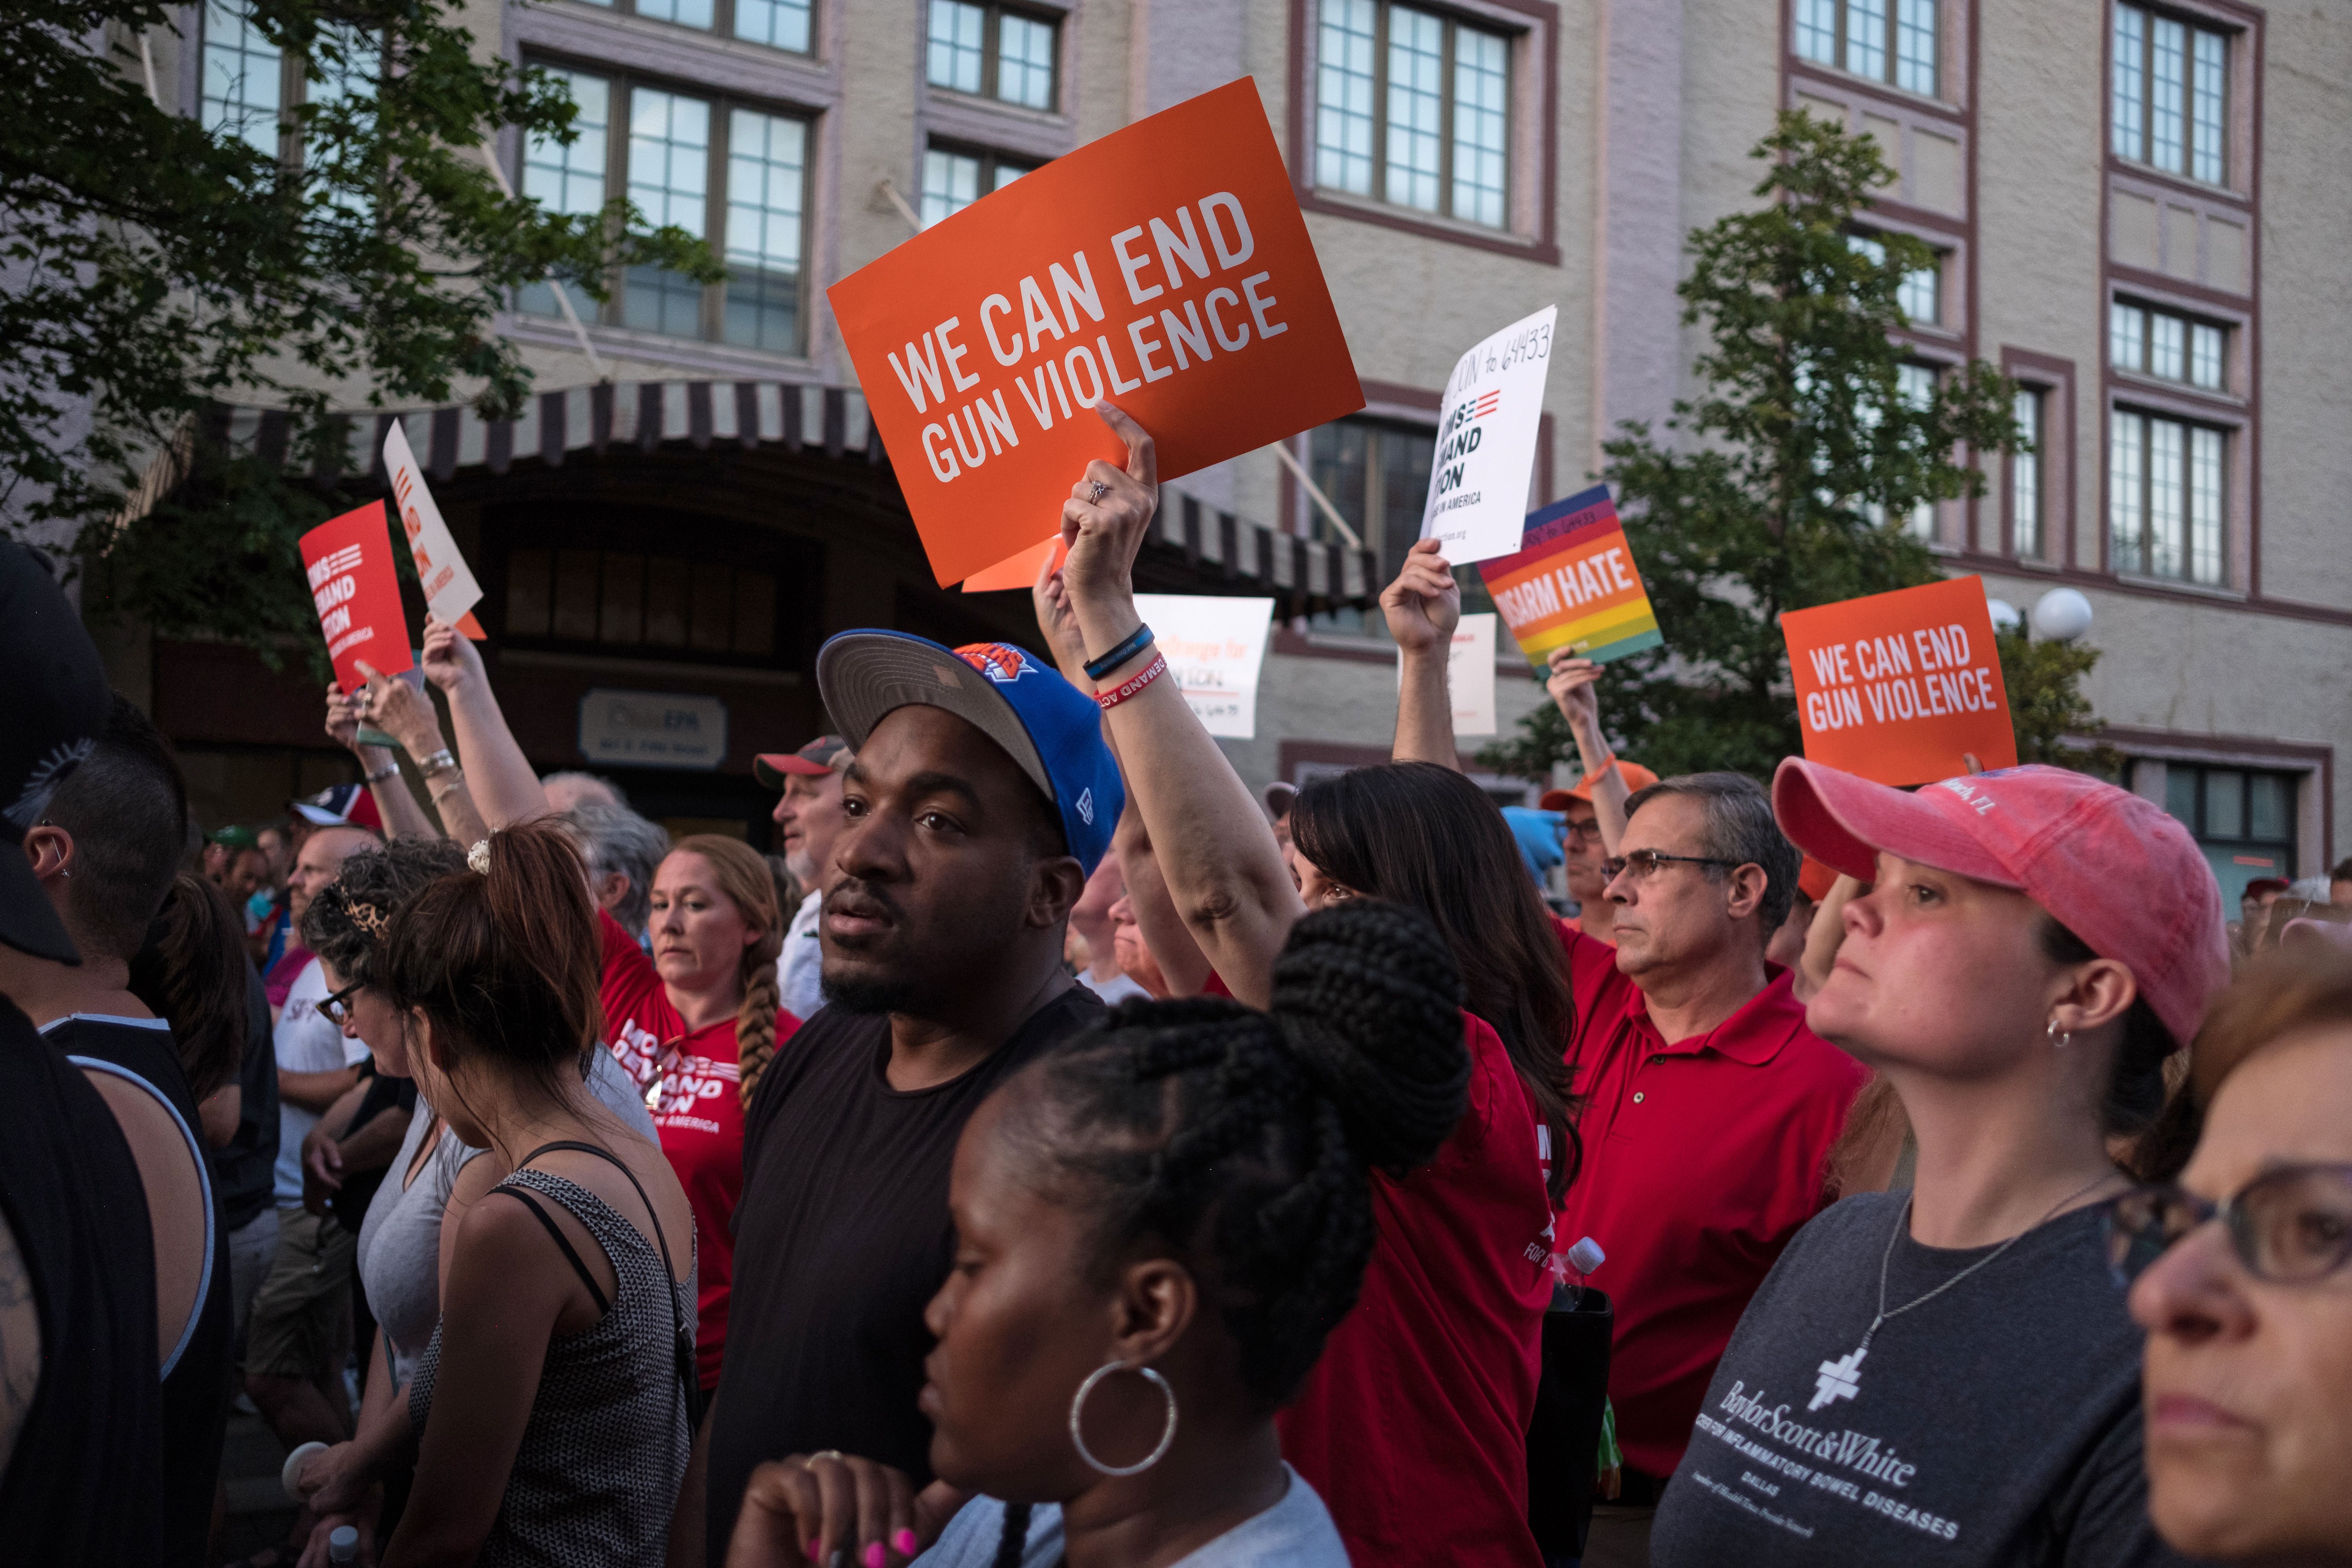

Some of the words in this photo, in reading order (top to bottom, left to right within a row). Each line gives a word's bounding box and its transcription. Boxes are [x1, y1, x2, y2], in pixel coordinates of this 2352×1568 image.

[887, 316, 980, 414] WE
[979, 250, 1105, 367] CAN
[1111, 191, 1255, 305] END
[1486, 346, 1497, 373] to
[1502, 323, 1550, 371] 64433
[921, 388, 1019, 483] GUN
[1015, 270, 1288, 430] VIOLENCE
[1446, 490, 1481, 511] AMERICA
[1555, 547, 1634, 609] HATE
[1120, 658, 1165, 696] DEMAND
[1809, 643, 1854, 687] WE
[1855, 633, 1912, 681] CAN
[1913, 624, 1971, 671] END
[1807, 685, 1864, 732] GUN
[1864, 667, 1997, 723] VIOLENCE
[1969, 795, 1996, 816] FL
[666, 1115, 720, 1134] AMERICA
[1523, 1241, 1546, 1263] FOR
[1721, 1429, 1814, 1481] INFLAMMATORY
[1809, 1471, 1860, 1501] BOWEL
[1862, 1491, 1960, 1540] DISEASES
[1741, 1471, 1780, 1497] DALLAS
